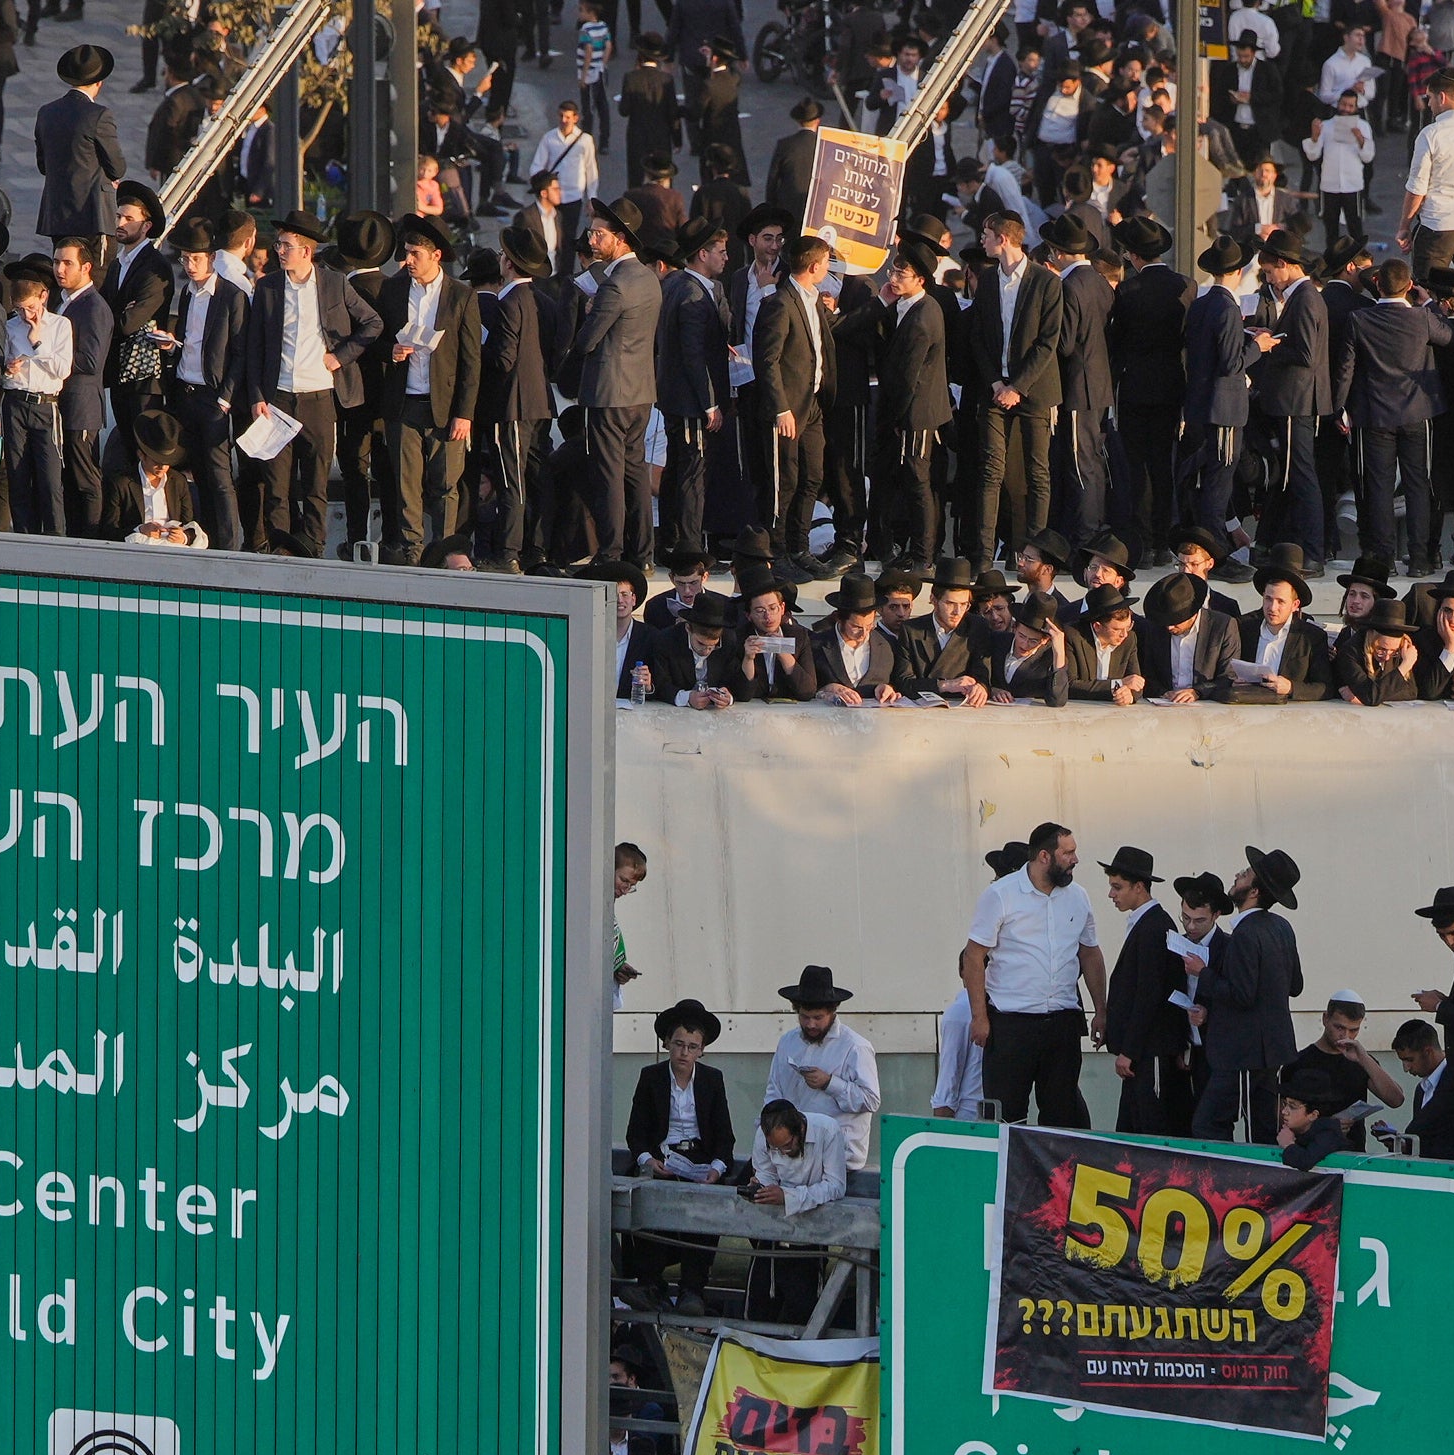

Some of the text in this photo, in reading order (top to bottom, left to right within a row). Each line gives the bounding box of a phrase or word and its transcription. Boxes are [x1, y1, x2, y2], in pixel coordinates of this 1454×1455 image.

[834, 148, 890, 177] מחזירים
[844, 168, 875, 190] אותו
[831, 183, 881, 209] לישיבה
[829, 203, 875, 228] עכשיו!
[216, 683, 408, 770] העיר
[133, 799, 346, 884] מרכז
[173, 916, 344, 1011] البلدة
[177, 1042, 350, 1140] مركز
[1064, 1163, 1312, 1322] 50%
[122, 1286, 290, 1380] City
[1018, 1298, 1256, 1342] השתגעתם???
[1086, 1359, 1108, 1375] עם
[1112, 1358, 1149, 1377] לרצח
[1154, 1362, 1205, 1378] הסכמה
[1221, 1364, 1258, 1380] הגיוס
[1264, 1364, 1288, 1382] חוק
